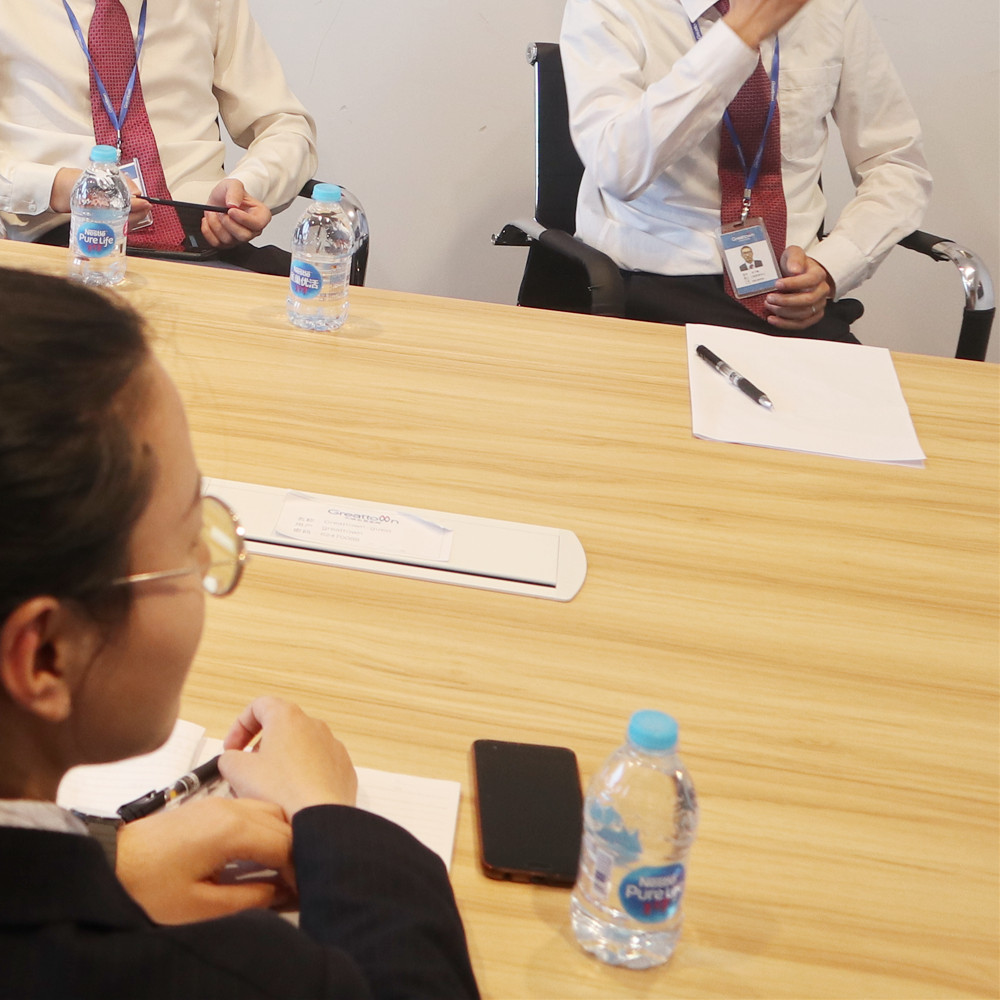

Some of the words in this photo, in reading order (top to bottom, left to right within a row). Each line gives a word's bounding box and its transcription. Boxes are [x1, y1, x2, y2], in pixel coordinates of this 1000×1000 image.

[79, 232, 99, 245] Pure
[99, 235, 115, 248] Life
[625, 884, 664, 901] Pure
